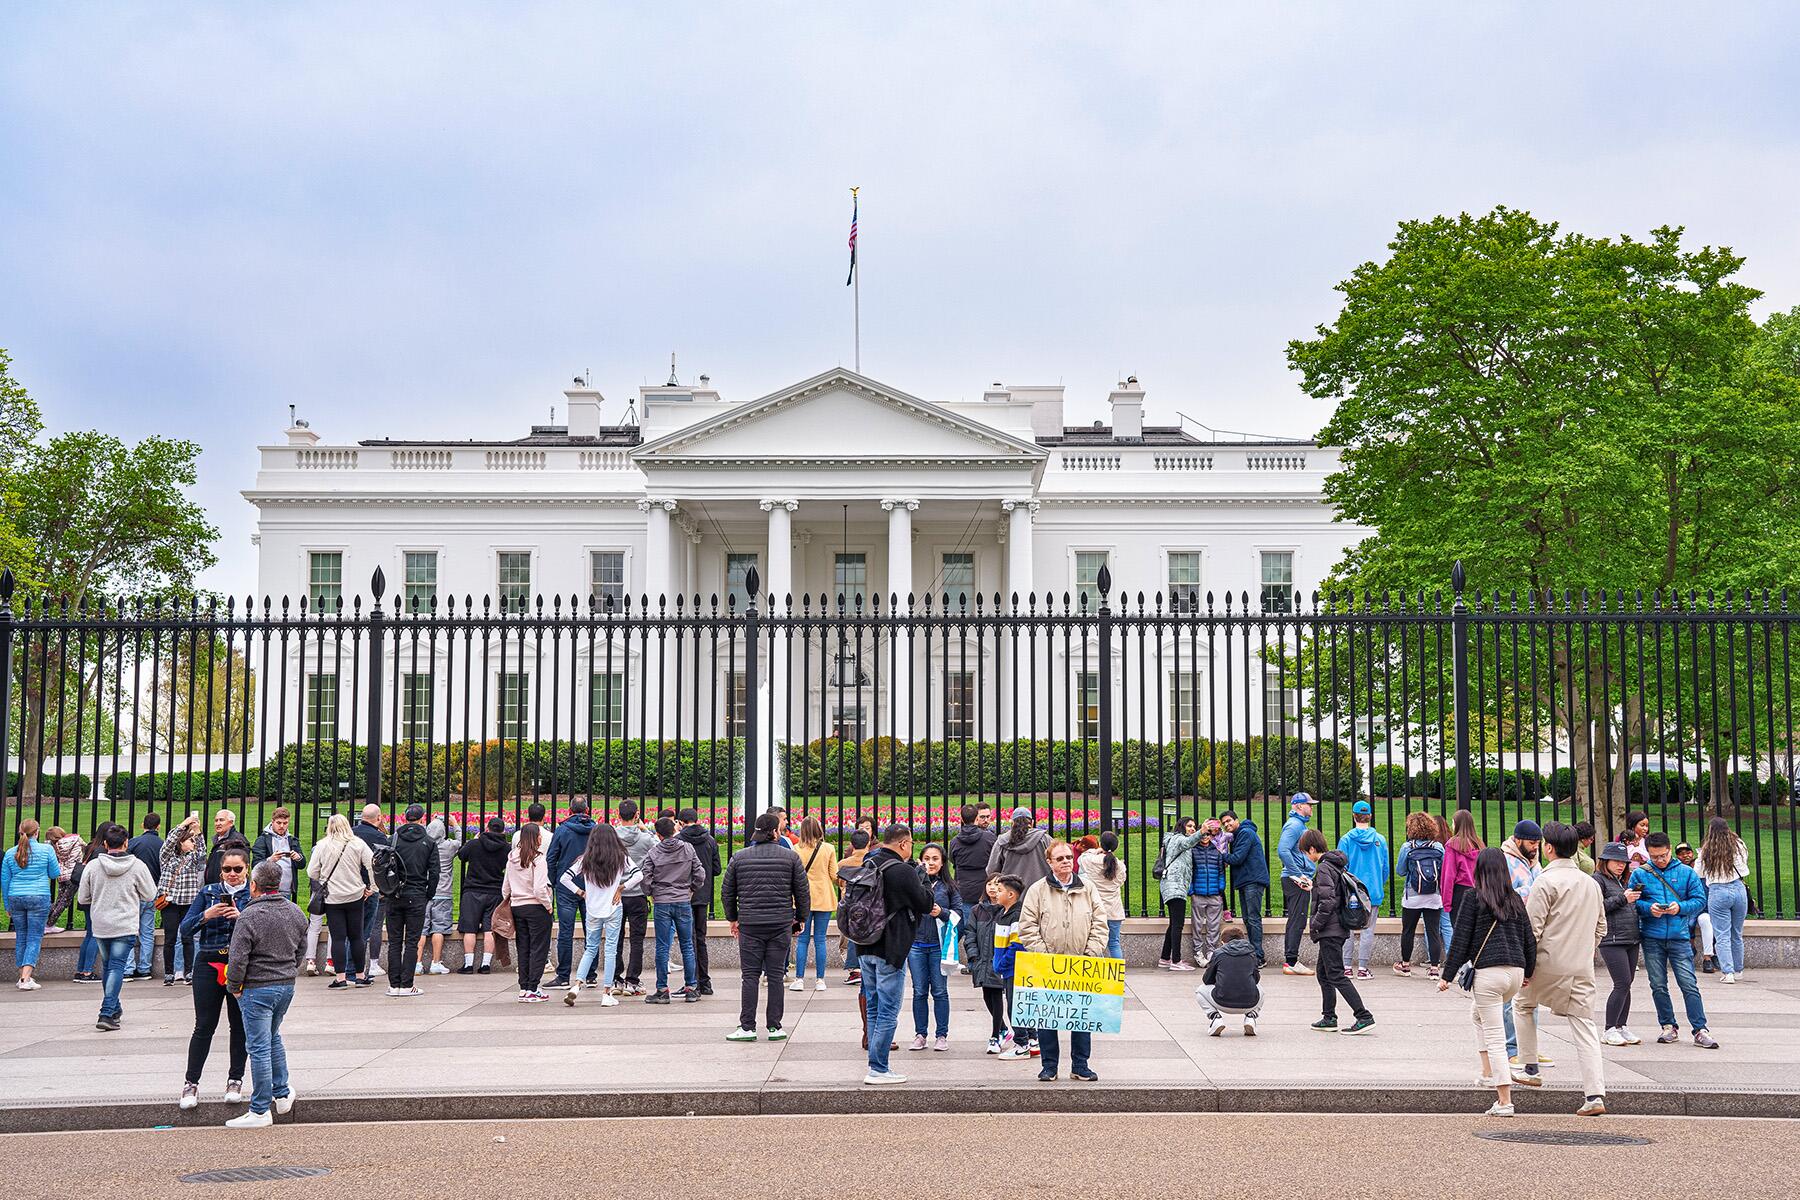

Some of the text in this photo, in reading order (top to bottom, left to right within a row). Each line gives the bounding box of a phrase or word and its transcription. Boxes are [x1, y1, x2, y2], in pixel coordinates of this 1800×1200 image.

[1051, 956, 1125, 982] UKRAINE
[1021, 975, 1103, 993] IS WINNING
[1016, 991, 1093, 1006] THE WAR TO
[1016, 1002, 1089, 1020] STABALIZE
[1015, 1017, 1103, 1032] WORLD ORDER
